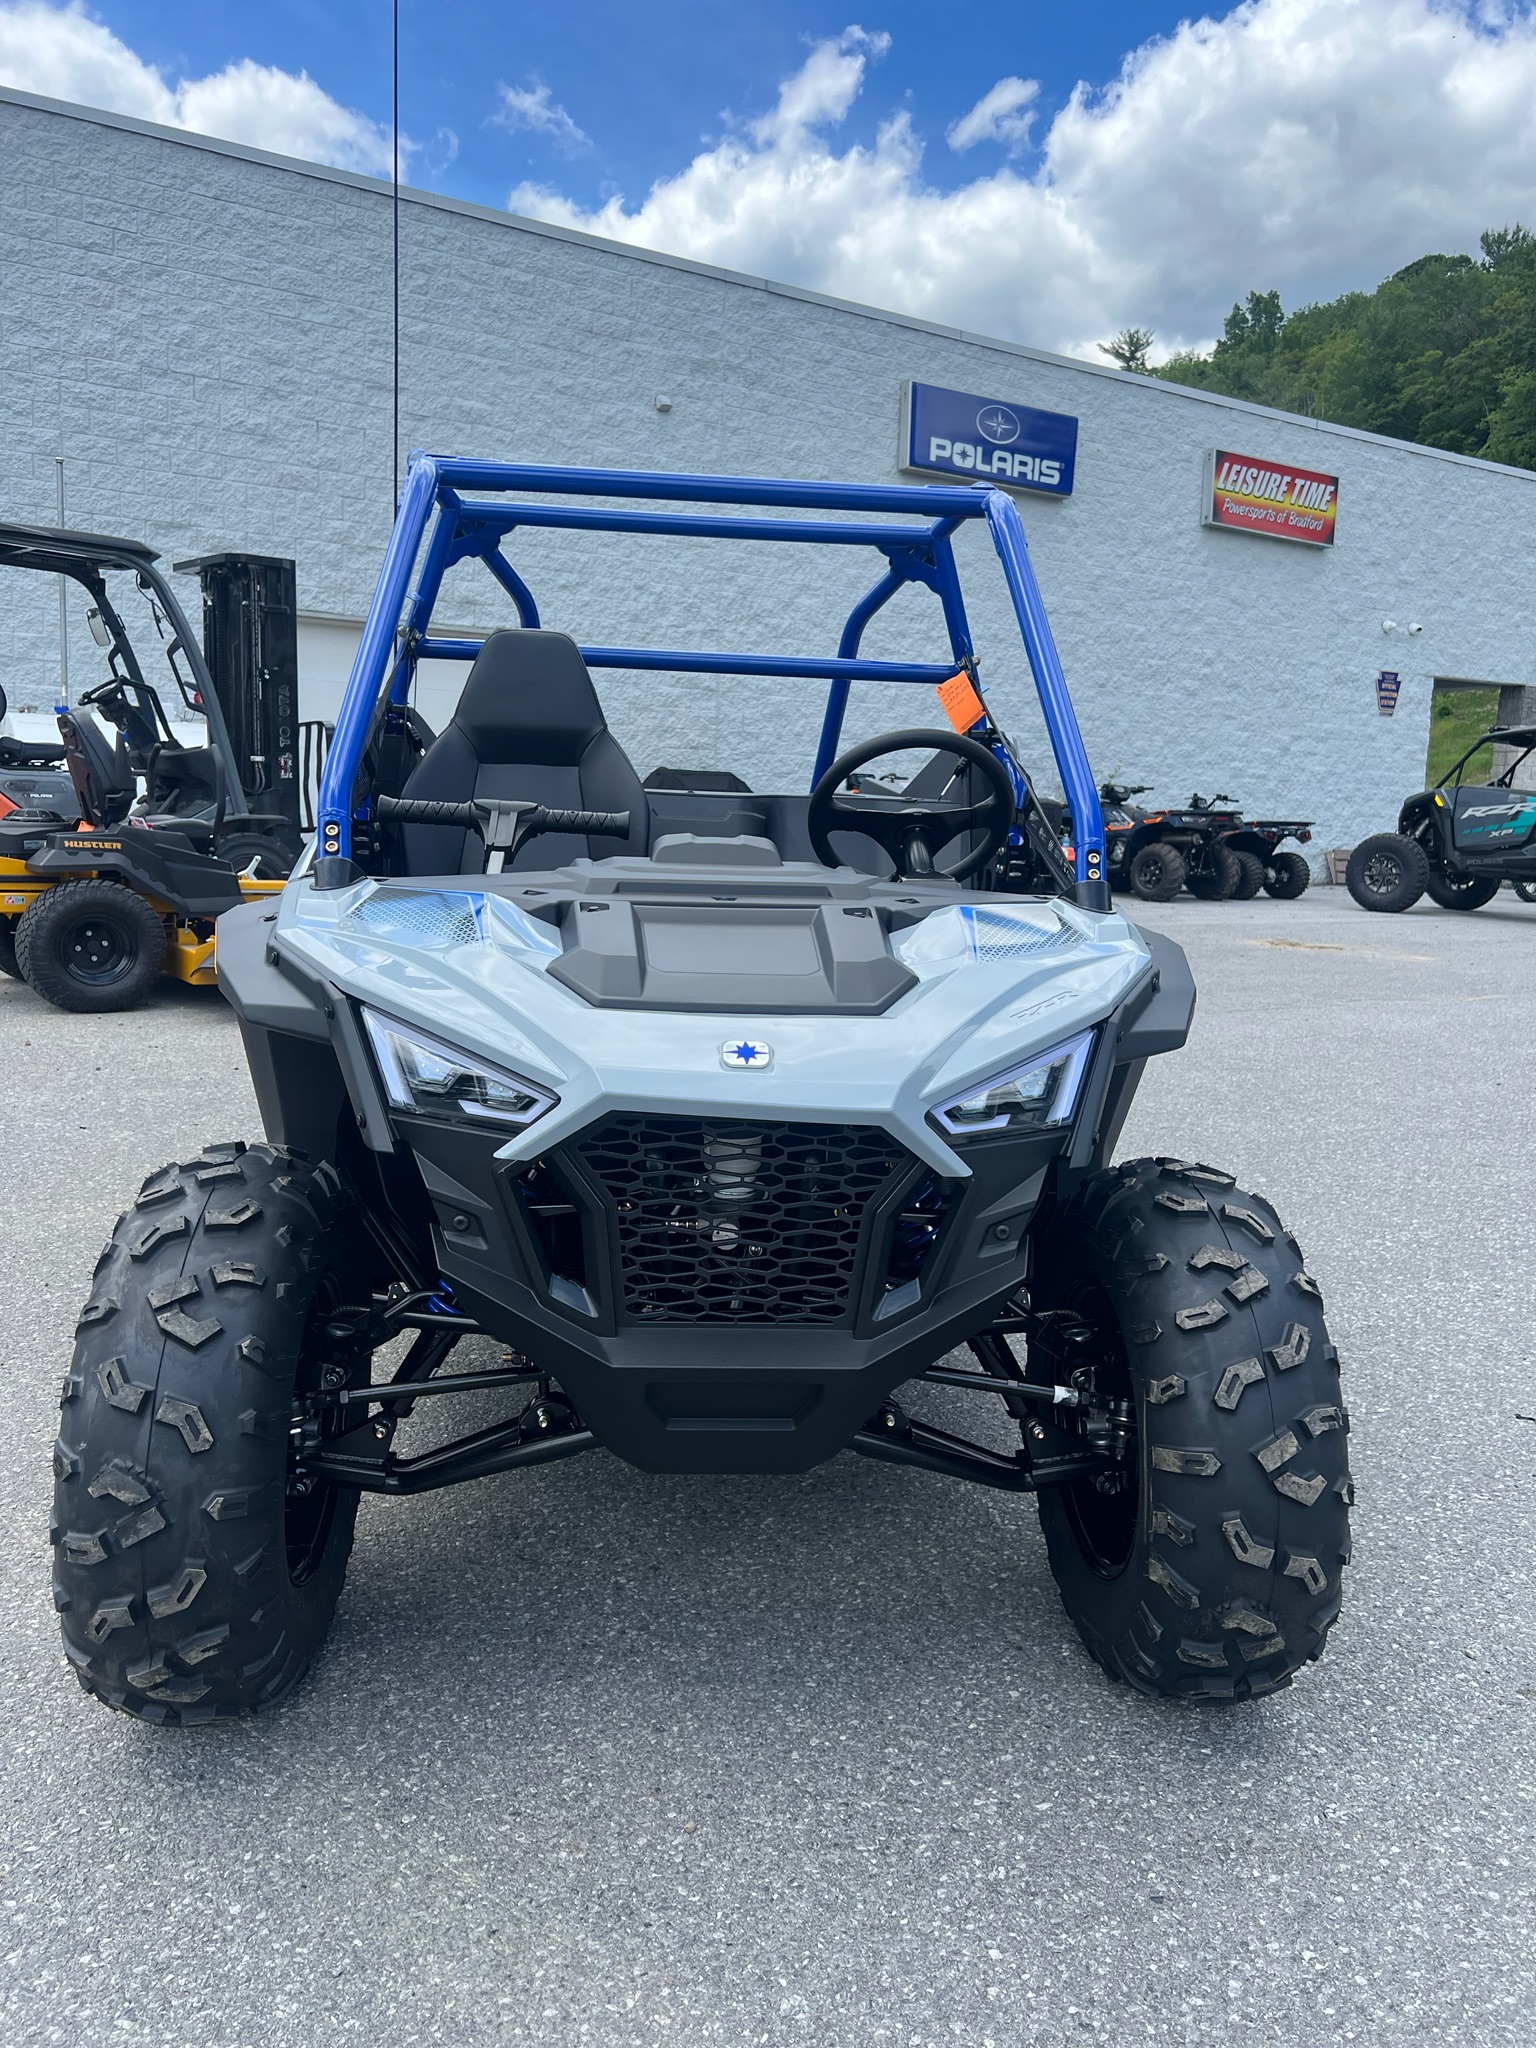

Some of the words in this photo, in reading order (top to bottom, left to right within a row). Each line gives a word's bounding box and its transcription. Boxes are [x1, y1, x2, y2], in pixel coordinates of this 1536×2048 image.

[929, 436, 1061, 485] POLARIS
[1217, 462, 1291, 504] LEISURE
[1290, 478, 1335, 512] TIME
[1222, 498, 1276, 523] Powersports
[1276, 510, 1288, 524] of
[1288, 511, 1325, 531] Bradford
[279, 684, 290, 746] TOOTA
[1460, 803, 1536, 819] RZR
[64, 840, 122, 850] HUSTLER
[1488, 828, 1513, 838] XP
[1466, 857, 1503, 866] POLARIS
